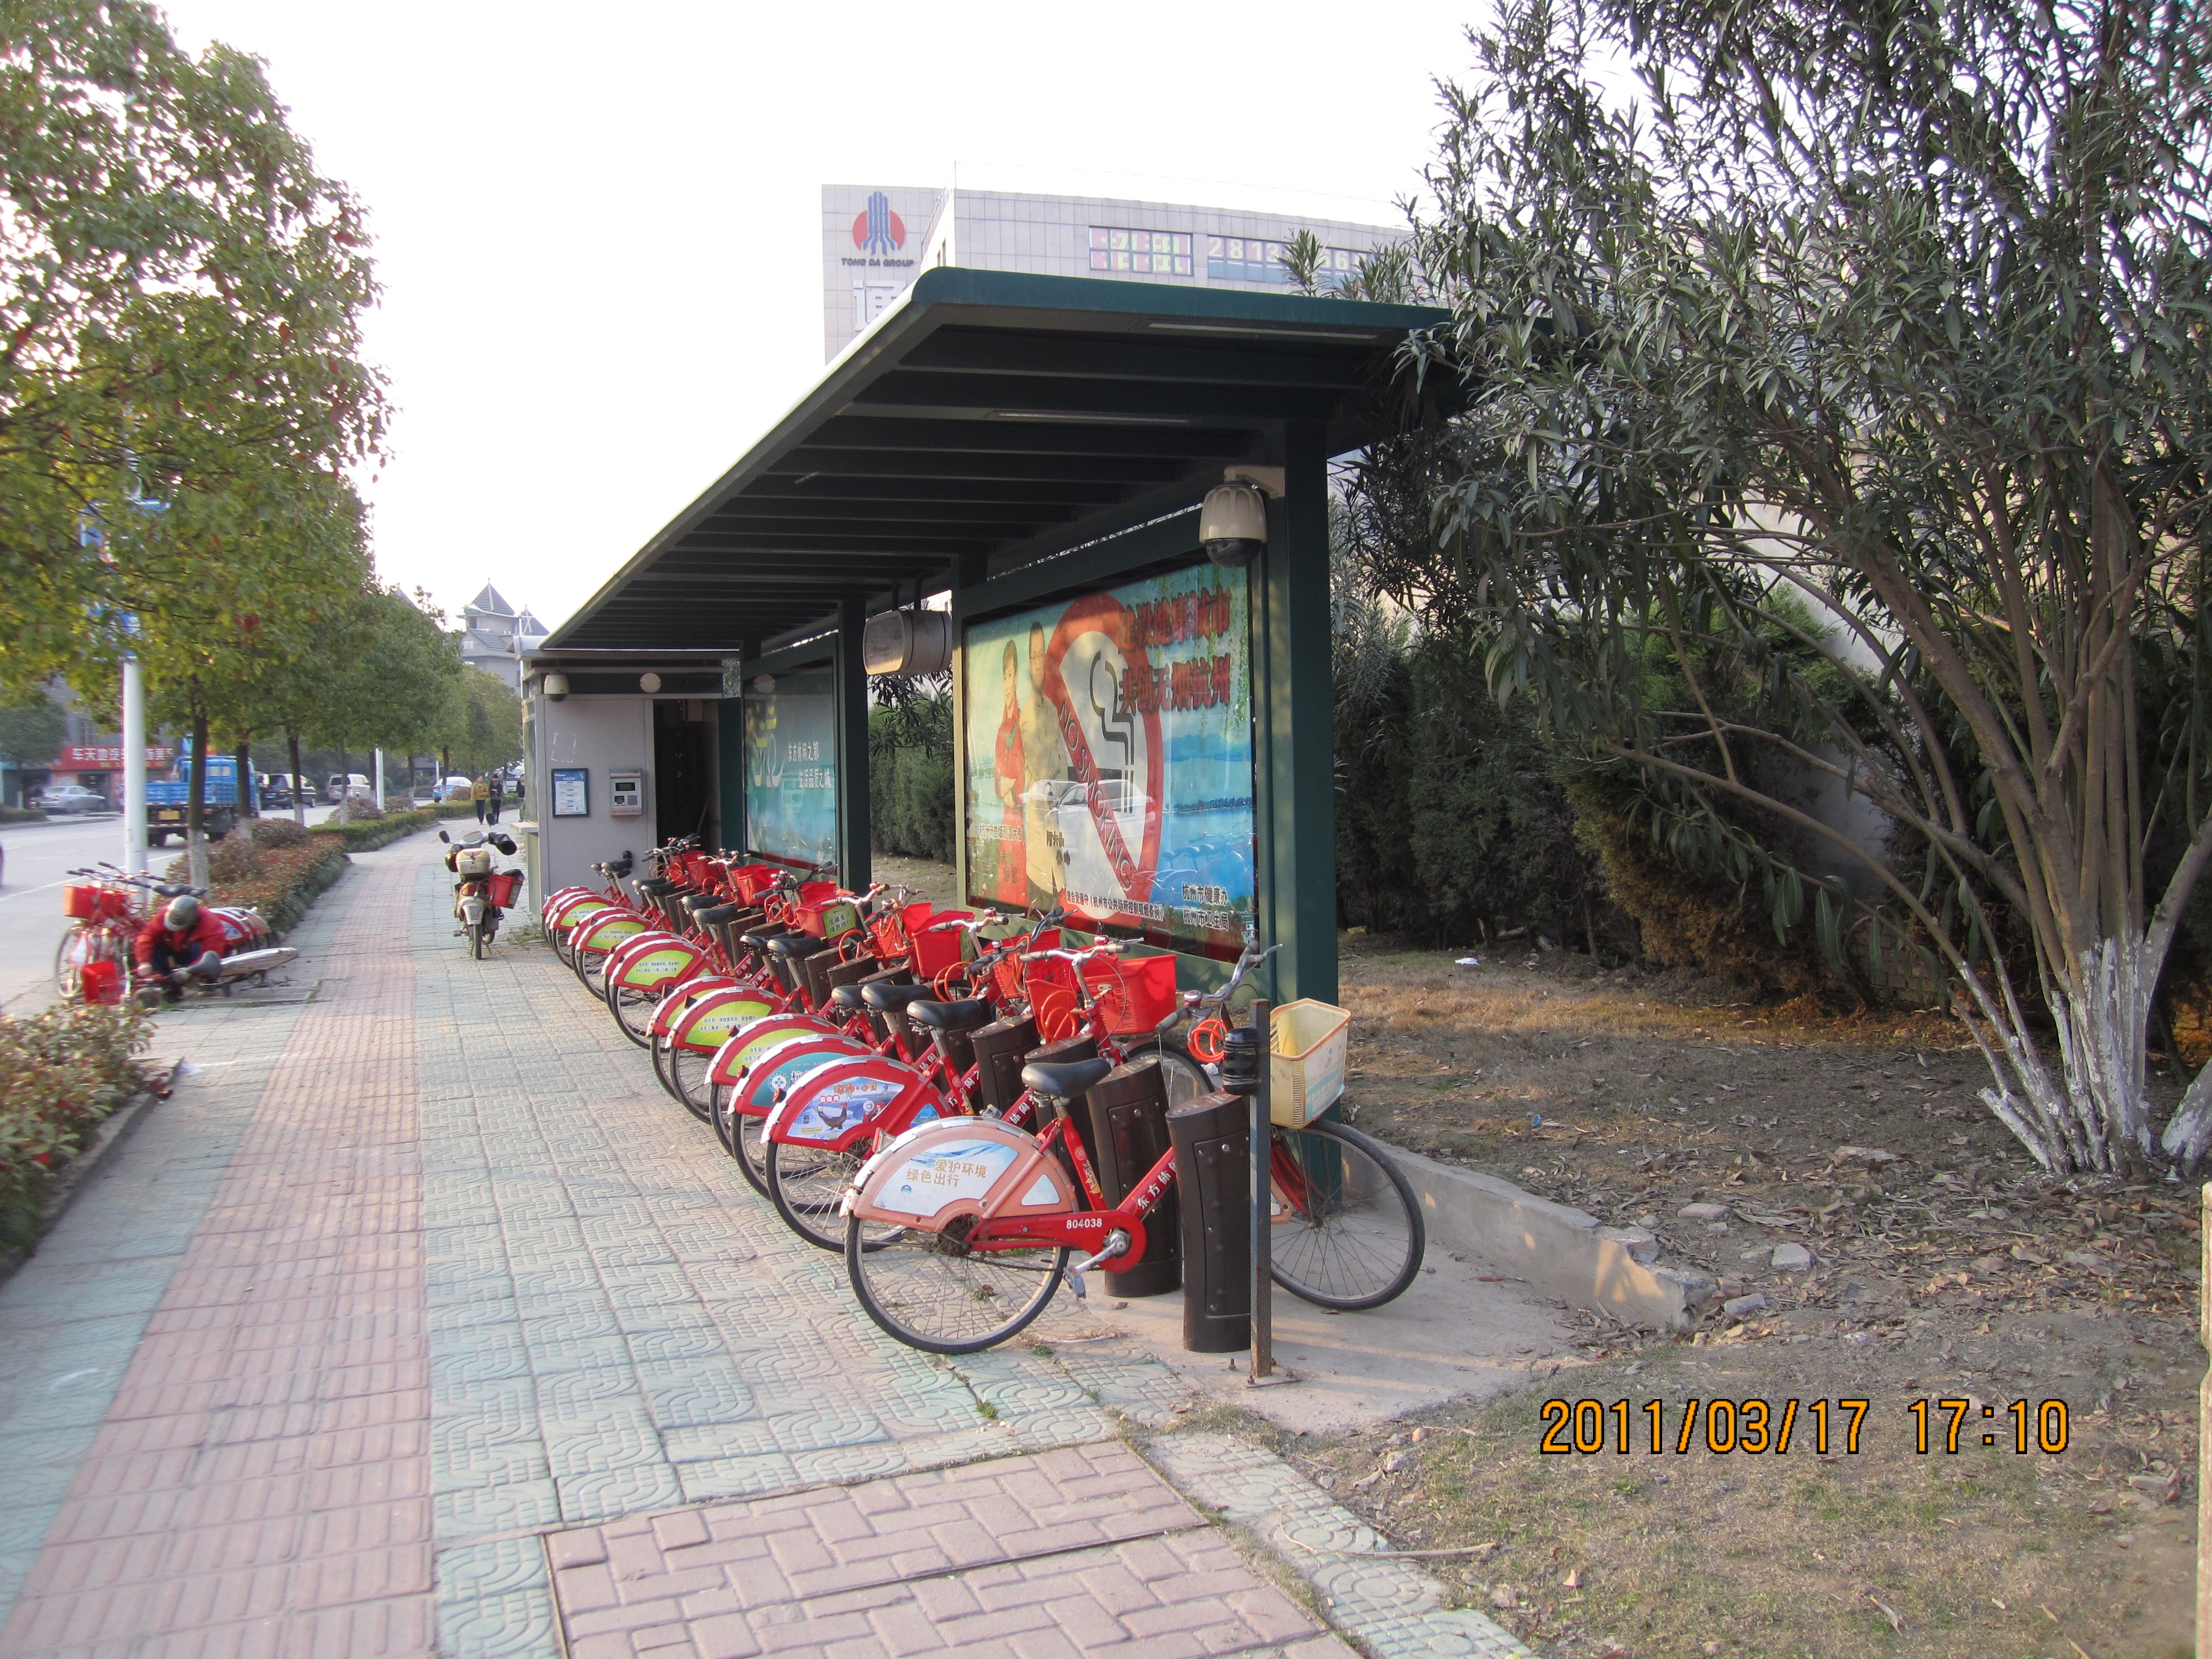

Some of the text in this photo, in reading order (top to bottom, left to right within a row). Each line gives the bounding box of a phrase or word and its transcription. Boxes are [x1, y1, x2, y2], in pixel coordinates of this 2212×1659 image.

[841, 258, 866, 266] TONG
[1118, 652, 1230, 716] 共创无烟杭州
[1059, 698, 1132, 892] NO SMOKING
[1182, 883, 1228, 906] 杭州市健康办
[1183, 906, 1229, 932] 杭州市卫生局
[905, 1168, 960, 1187] 绿色出行
[935, 1159, 987, 1178] 爱护环境
[1066, 1218, 1102, 1229] 804038
